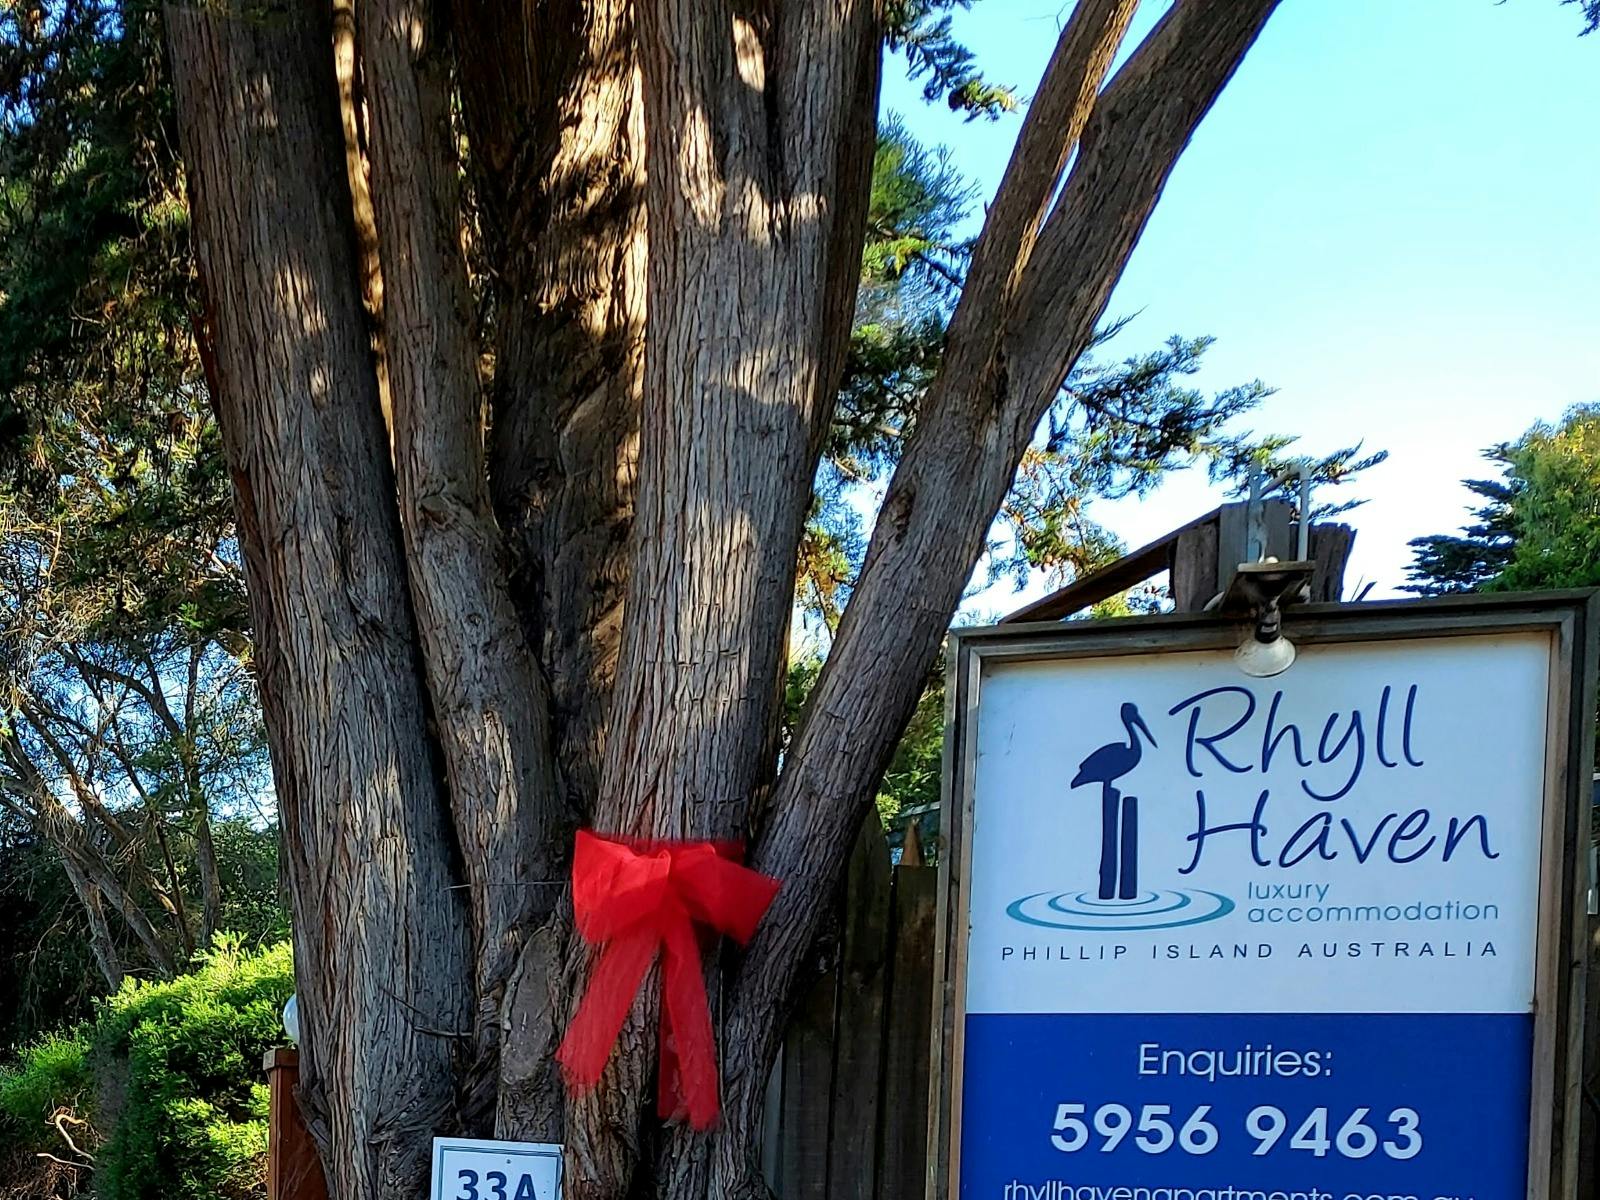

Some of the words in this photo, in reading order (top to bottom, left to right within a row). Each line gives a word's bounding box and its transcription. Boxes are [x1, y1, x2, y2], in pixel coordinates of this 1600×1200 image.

[1168, 684, 1424, 801] Rhyll
[1177, 789, 1500, 875] Haven
[1247, 901, 1499, 923] accommodation
[1248, 881, 1330, 904] luxury
[1002, 945, 1128, 961] PHILLIP
[1152, 943, 1273, 960] ISLAND
[1298, 941, 1497, 958] AUSTRALIA
[1138, 1043, 1333, 1082] Enquiries:
[1050, 1103, 1219, 1156] 5956
[1245, 1105, 1424, 1159] 9463
